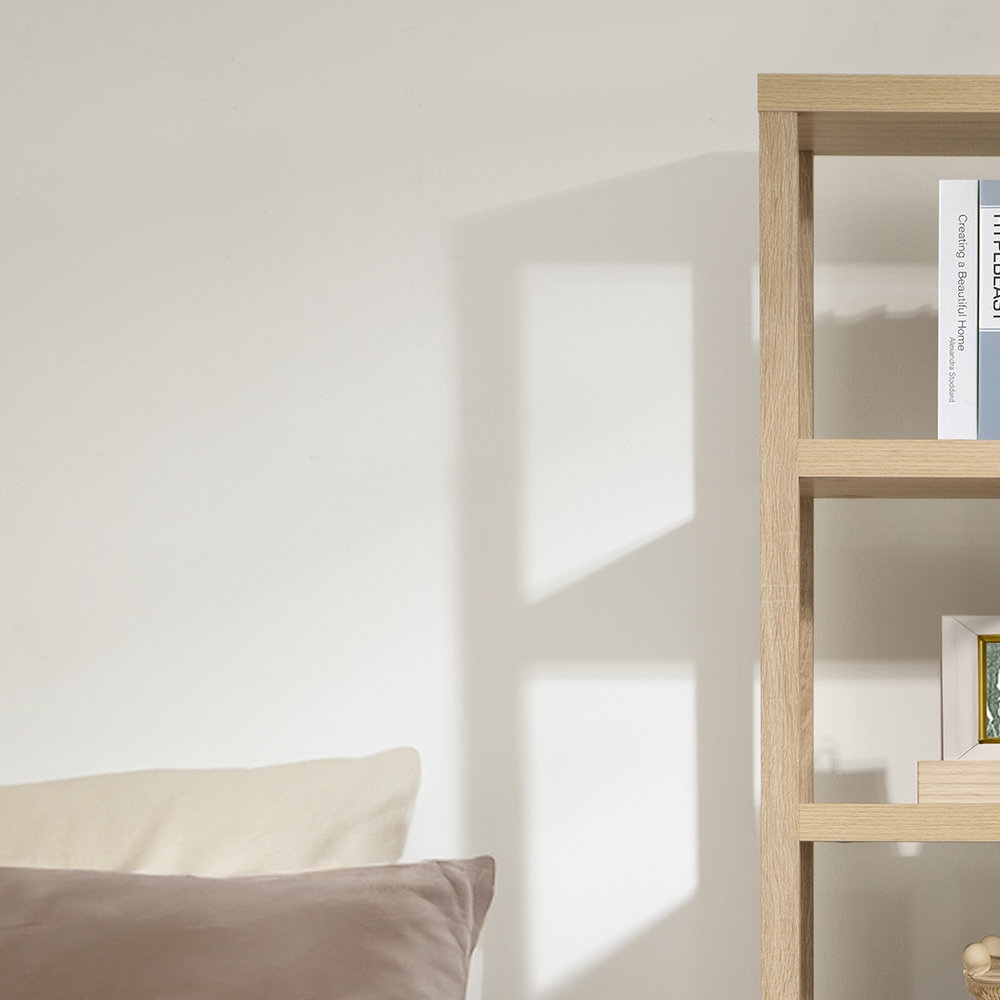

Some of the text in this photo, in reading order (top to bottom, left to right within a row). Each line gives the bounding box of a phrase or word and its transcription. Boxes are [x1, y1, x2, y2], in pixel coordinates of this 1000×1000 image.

[956, 213, 968, 259] Creating
[957, 271, 968, 317] Beautiful
[957, 320, 968, 351] Home
